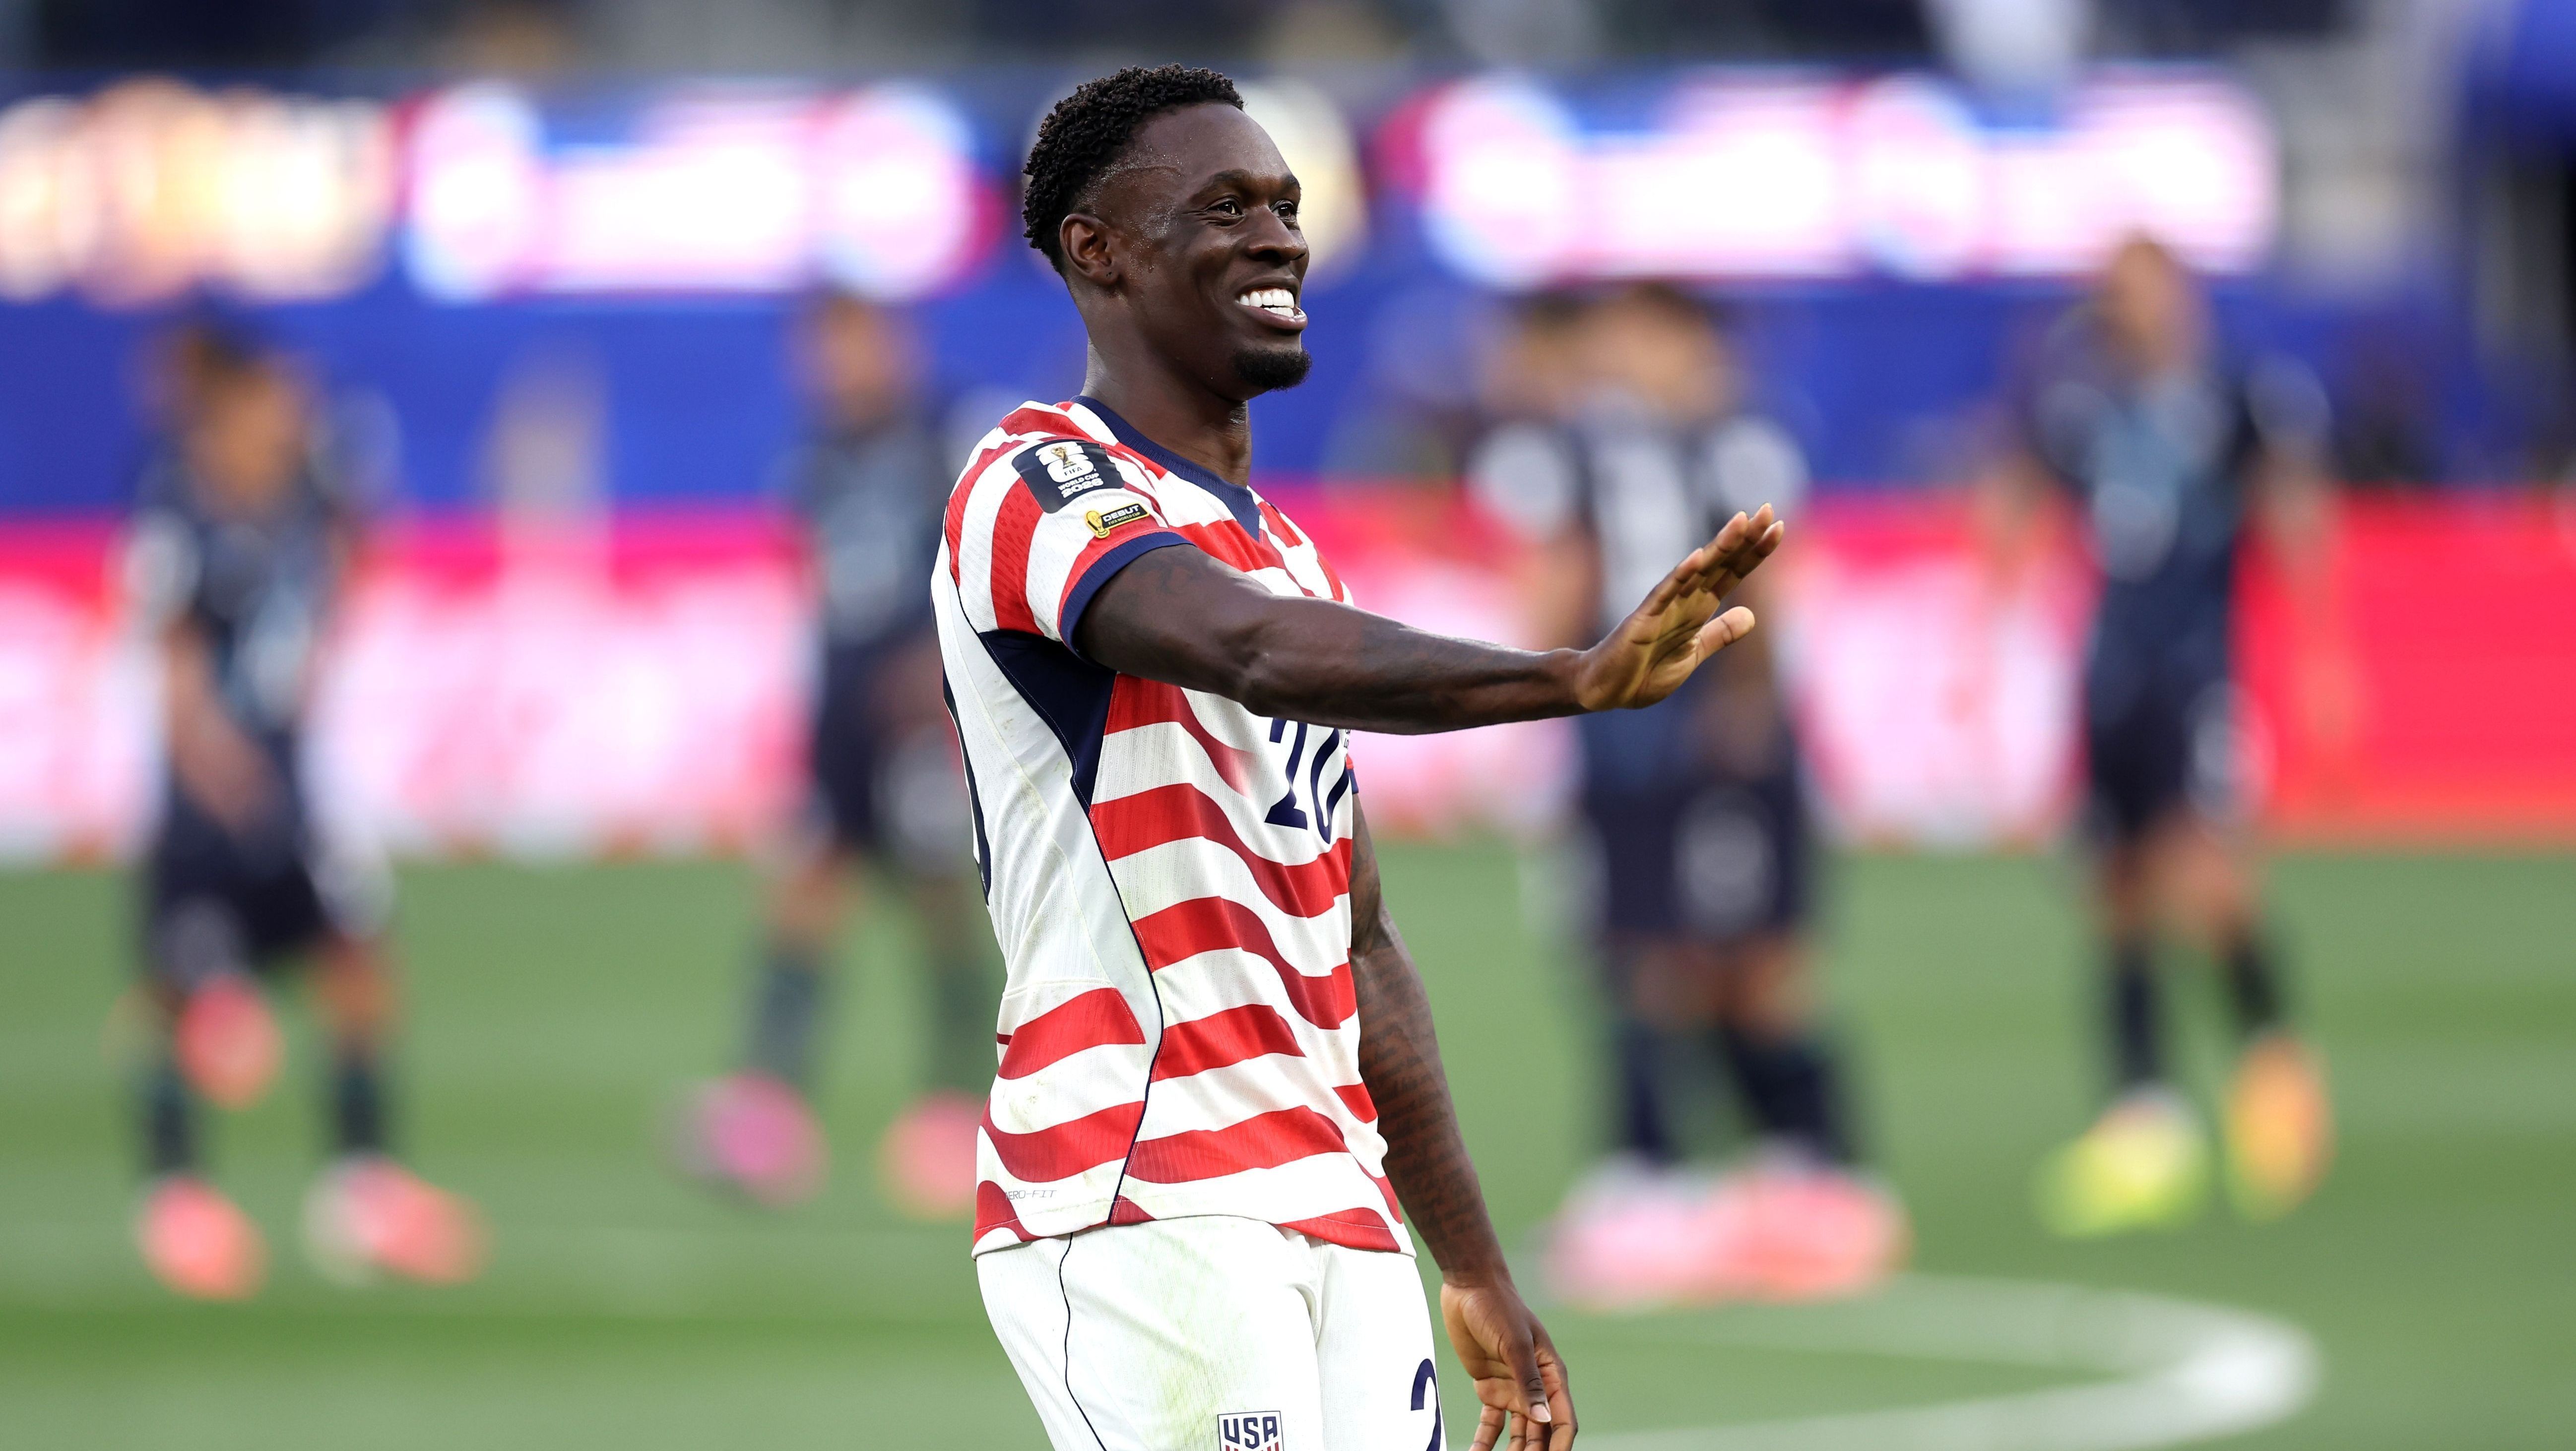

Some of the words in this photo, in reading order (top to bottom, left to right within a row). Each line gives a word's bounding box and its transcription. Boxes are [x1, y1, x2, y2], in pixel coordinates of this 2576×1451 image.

[1064, 467, 1083, 476] FIFA
[1058, 477, 1085, 491] WORLD
[1061, 478, 1104, 499] 2026
[1102, 505, 1139, 522] DEBUT
[1264, 717, 1350, 844] 20
[1005, 1190, 1057, 1200] AERO-FIT
[1223, 1416, 1278, 1450] USA
